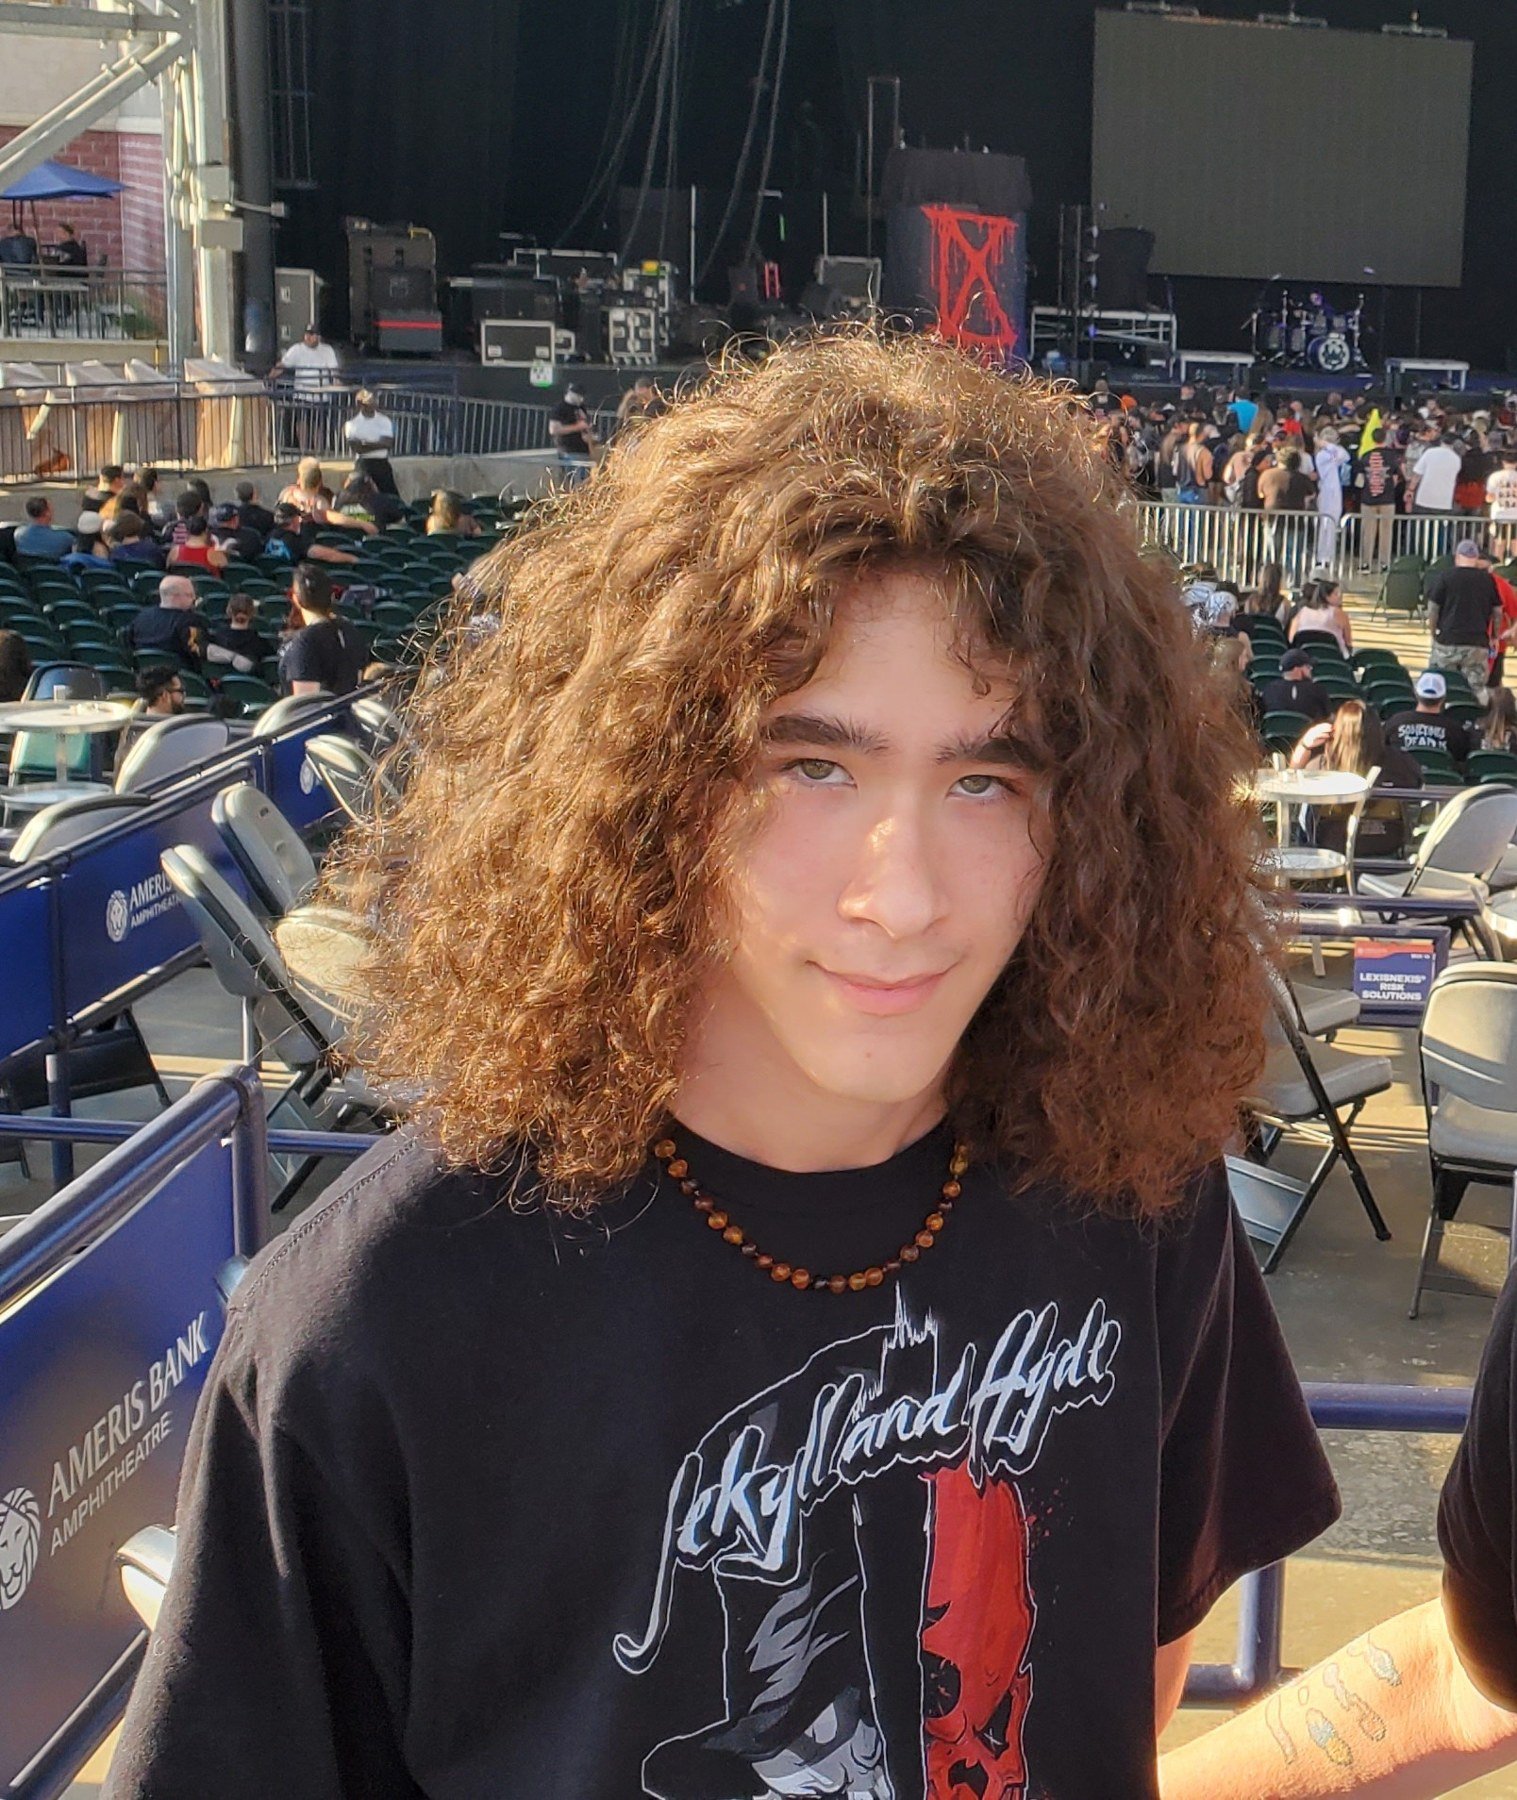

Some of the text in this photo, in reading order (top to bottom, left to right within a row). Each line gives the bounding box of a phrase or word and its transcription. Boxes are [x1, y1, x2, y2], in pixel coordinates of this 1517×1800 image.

[1362, 990, 1422, 1000] SOLUTIONS
[1380, 982, 1405, 991] RISK
[47, 1310, 209, 1519] AMERIS BANK
[840, 1350, 974, 1472] and
[50, 1410, 174, 1557] AMPHITHEATRE
